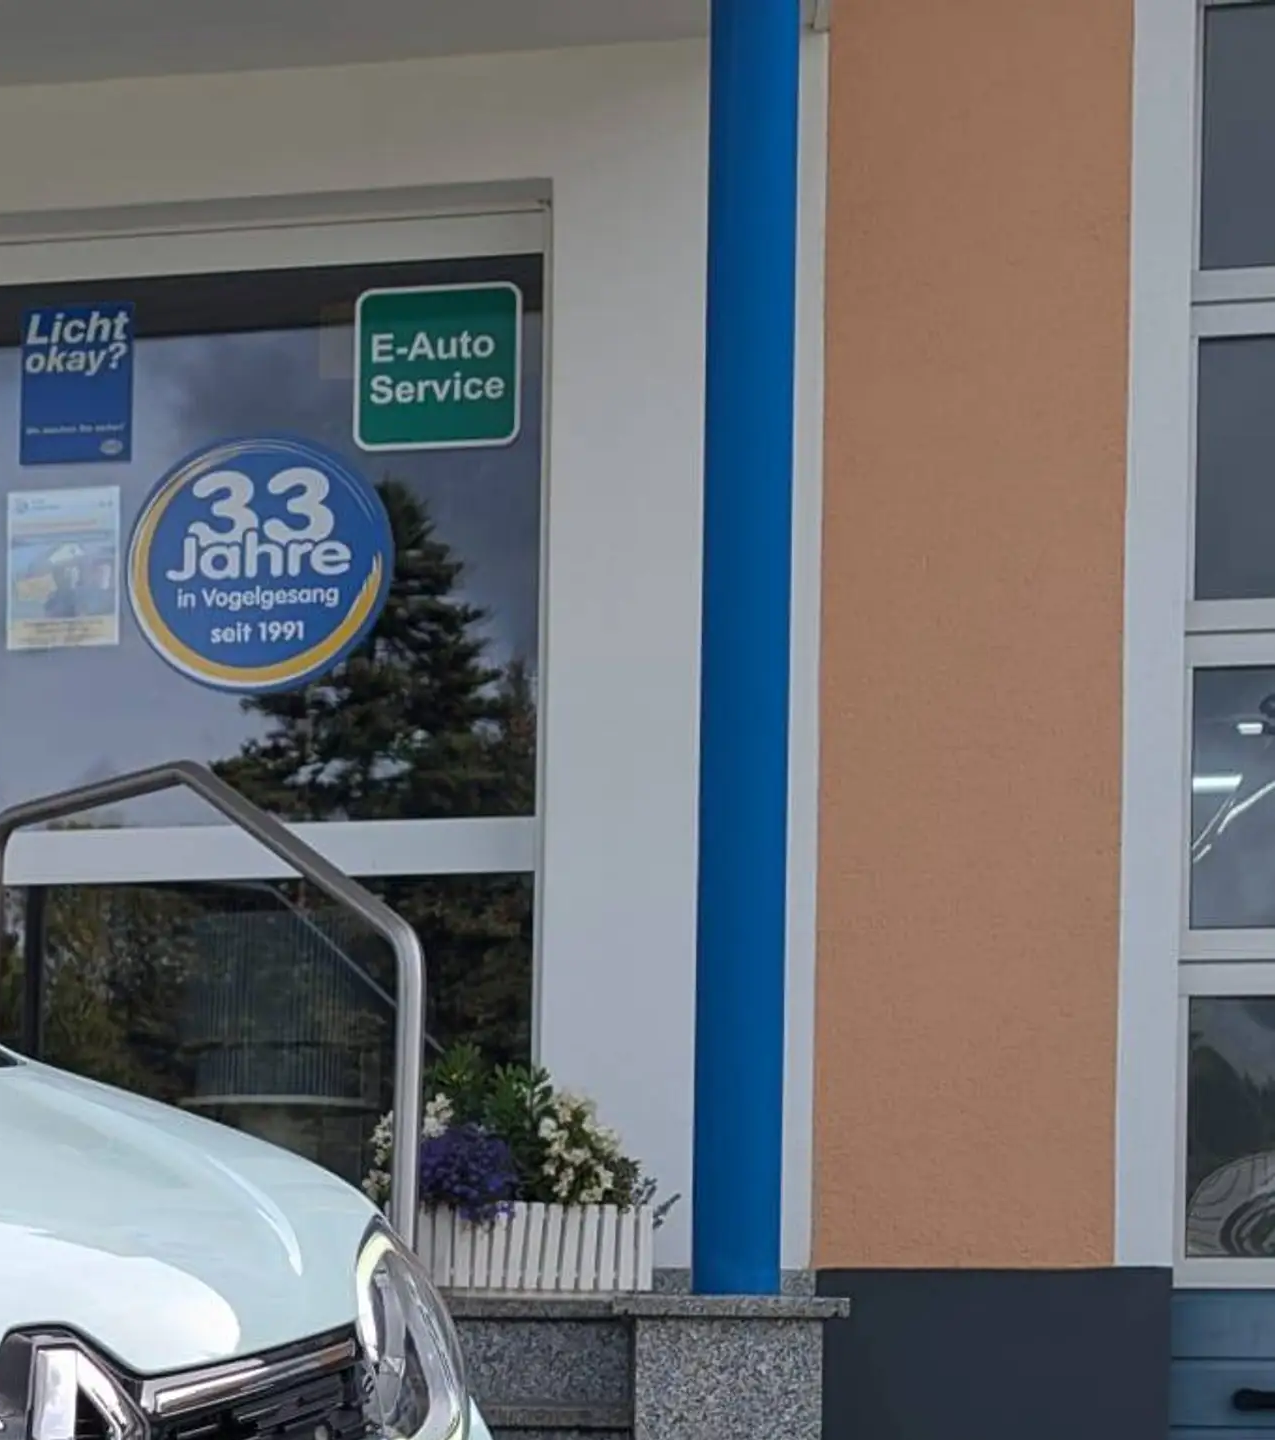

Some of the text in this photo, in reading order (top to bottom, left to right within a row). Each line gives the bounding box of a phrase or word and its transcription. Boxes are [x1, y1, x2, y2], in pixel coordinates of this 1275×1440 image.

[27, 312, 129, 345] Licht
[26, 342, 128, 376] okay?
[372, 330, 495, 362] E-Auto
[370, 374, 504, 404] Service
[192, 467, 335, 543] 33
[166, 527, 351, 581] Jahre
[178, 586, 339, 611] in Vogelgesang
[210, 620, 305, 643] seit 1991
